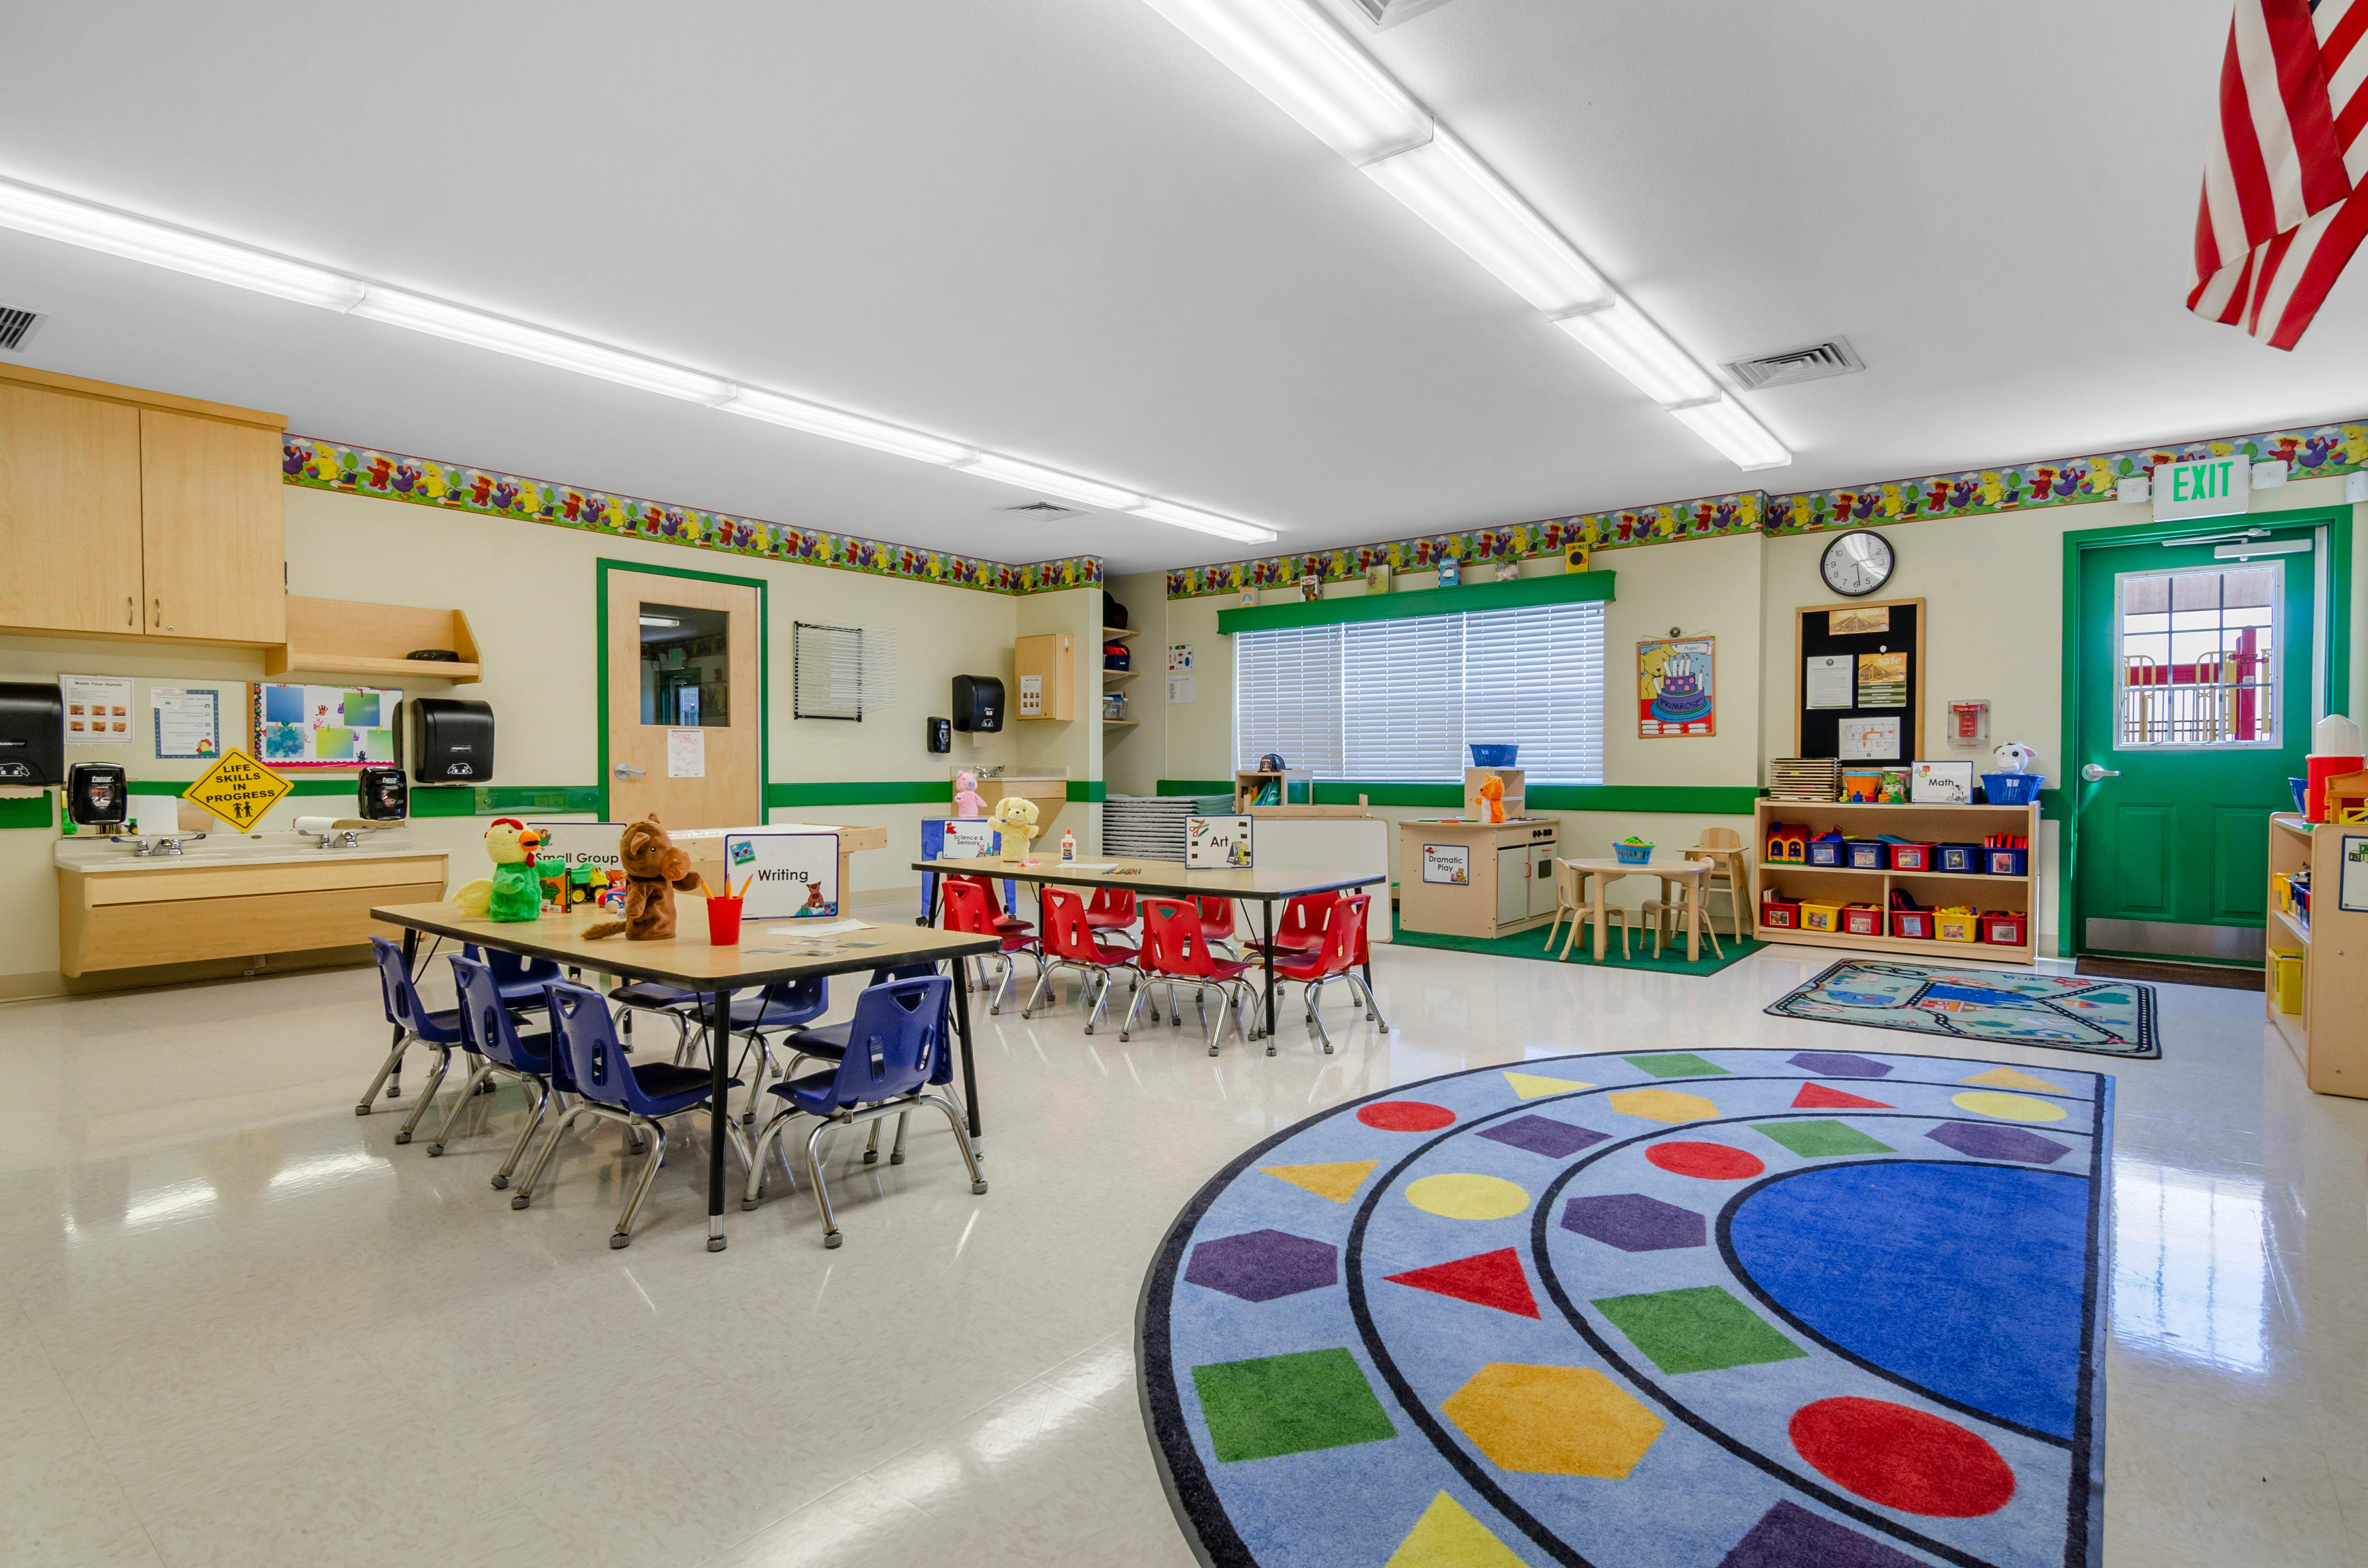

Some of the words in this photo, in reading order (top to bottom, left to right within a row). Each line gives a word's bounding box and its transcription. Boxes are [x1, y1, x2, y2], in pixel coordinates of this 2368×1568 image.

[2173, 461, 2233, 502] EXIT
[1878, 655, 1902, 665] safe
[1660, 698, 1703, 710] PRIMROSE
[223, 764, 251, 773] LIFE
[215, 773, 260, 783] SKILLS
[206, 790, 275, 803] PROGRESS
[1210, 836, 1229, 847] Art
[536, 853, 571, 863] Smll
[577, 853, 619, 865] Group
[1429, 856, 1463, 864] Dramatic
[1438, 864, 1453, 873] Play
[758, 869, 808, 883] Writing
